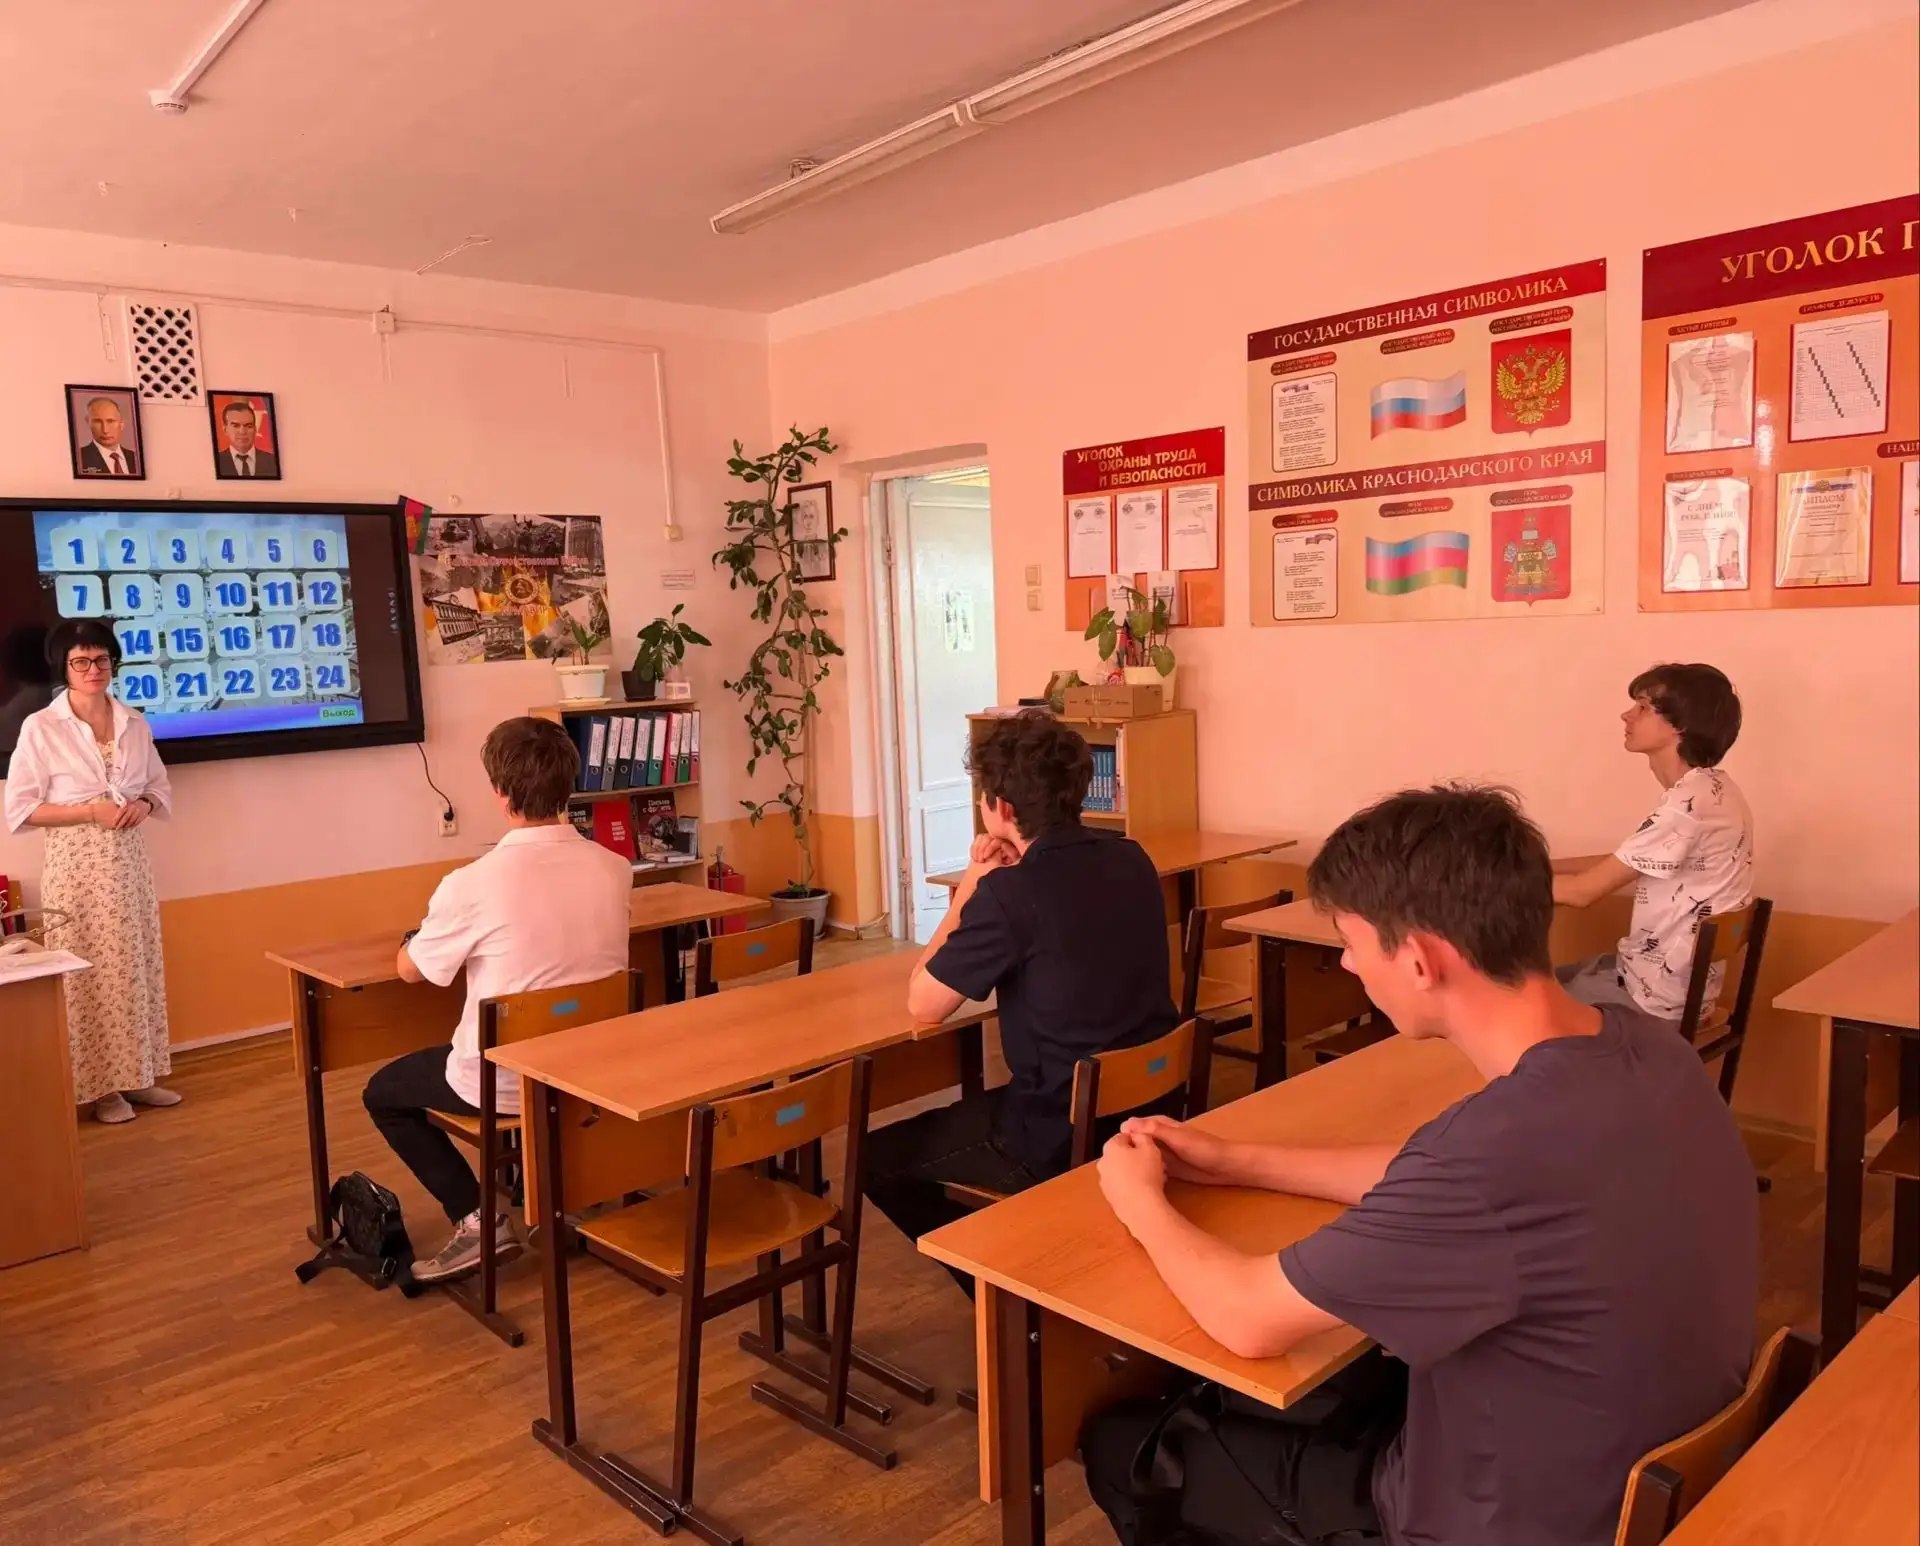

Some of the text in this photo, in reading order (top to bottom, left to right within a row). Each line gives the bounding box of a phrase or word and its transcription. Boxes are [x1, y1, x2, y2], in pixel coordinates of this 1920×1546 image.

[1720, 227, 1885, 283] УГОЛОК
[1274, 303, 1438, 350] ГОСУДАРСТВЕННАЯ
[1444, 276, 1568, 315] СИМВОЛИКА
[1077, 445, 1124, 463] УГОЛОК
[1100, 448, 1197, 473] ОХРАНЫ ТРУДА
[1111, 462, 1207, 486] БЕЗОПАСНОСТИ
[1257, 448, 1593, 503] СИМВОЛИКА КРАСНОДАРСКОГО КРАЯ
[68, 538, 326, 564] 1 2 3 4 5 6
[72, 581, 337, 611] 7 8 9 10 11 12
[120, 623, 341, 655] 14 15 16 17 18
[125, 664, 345, 700] 20 21 22 23 24
[322, 707, 355, 718] Выход
